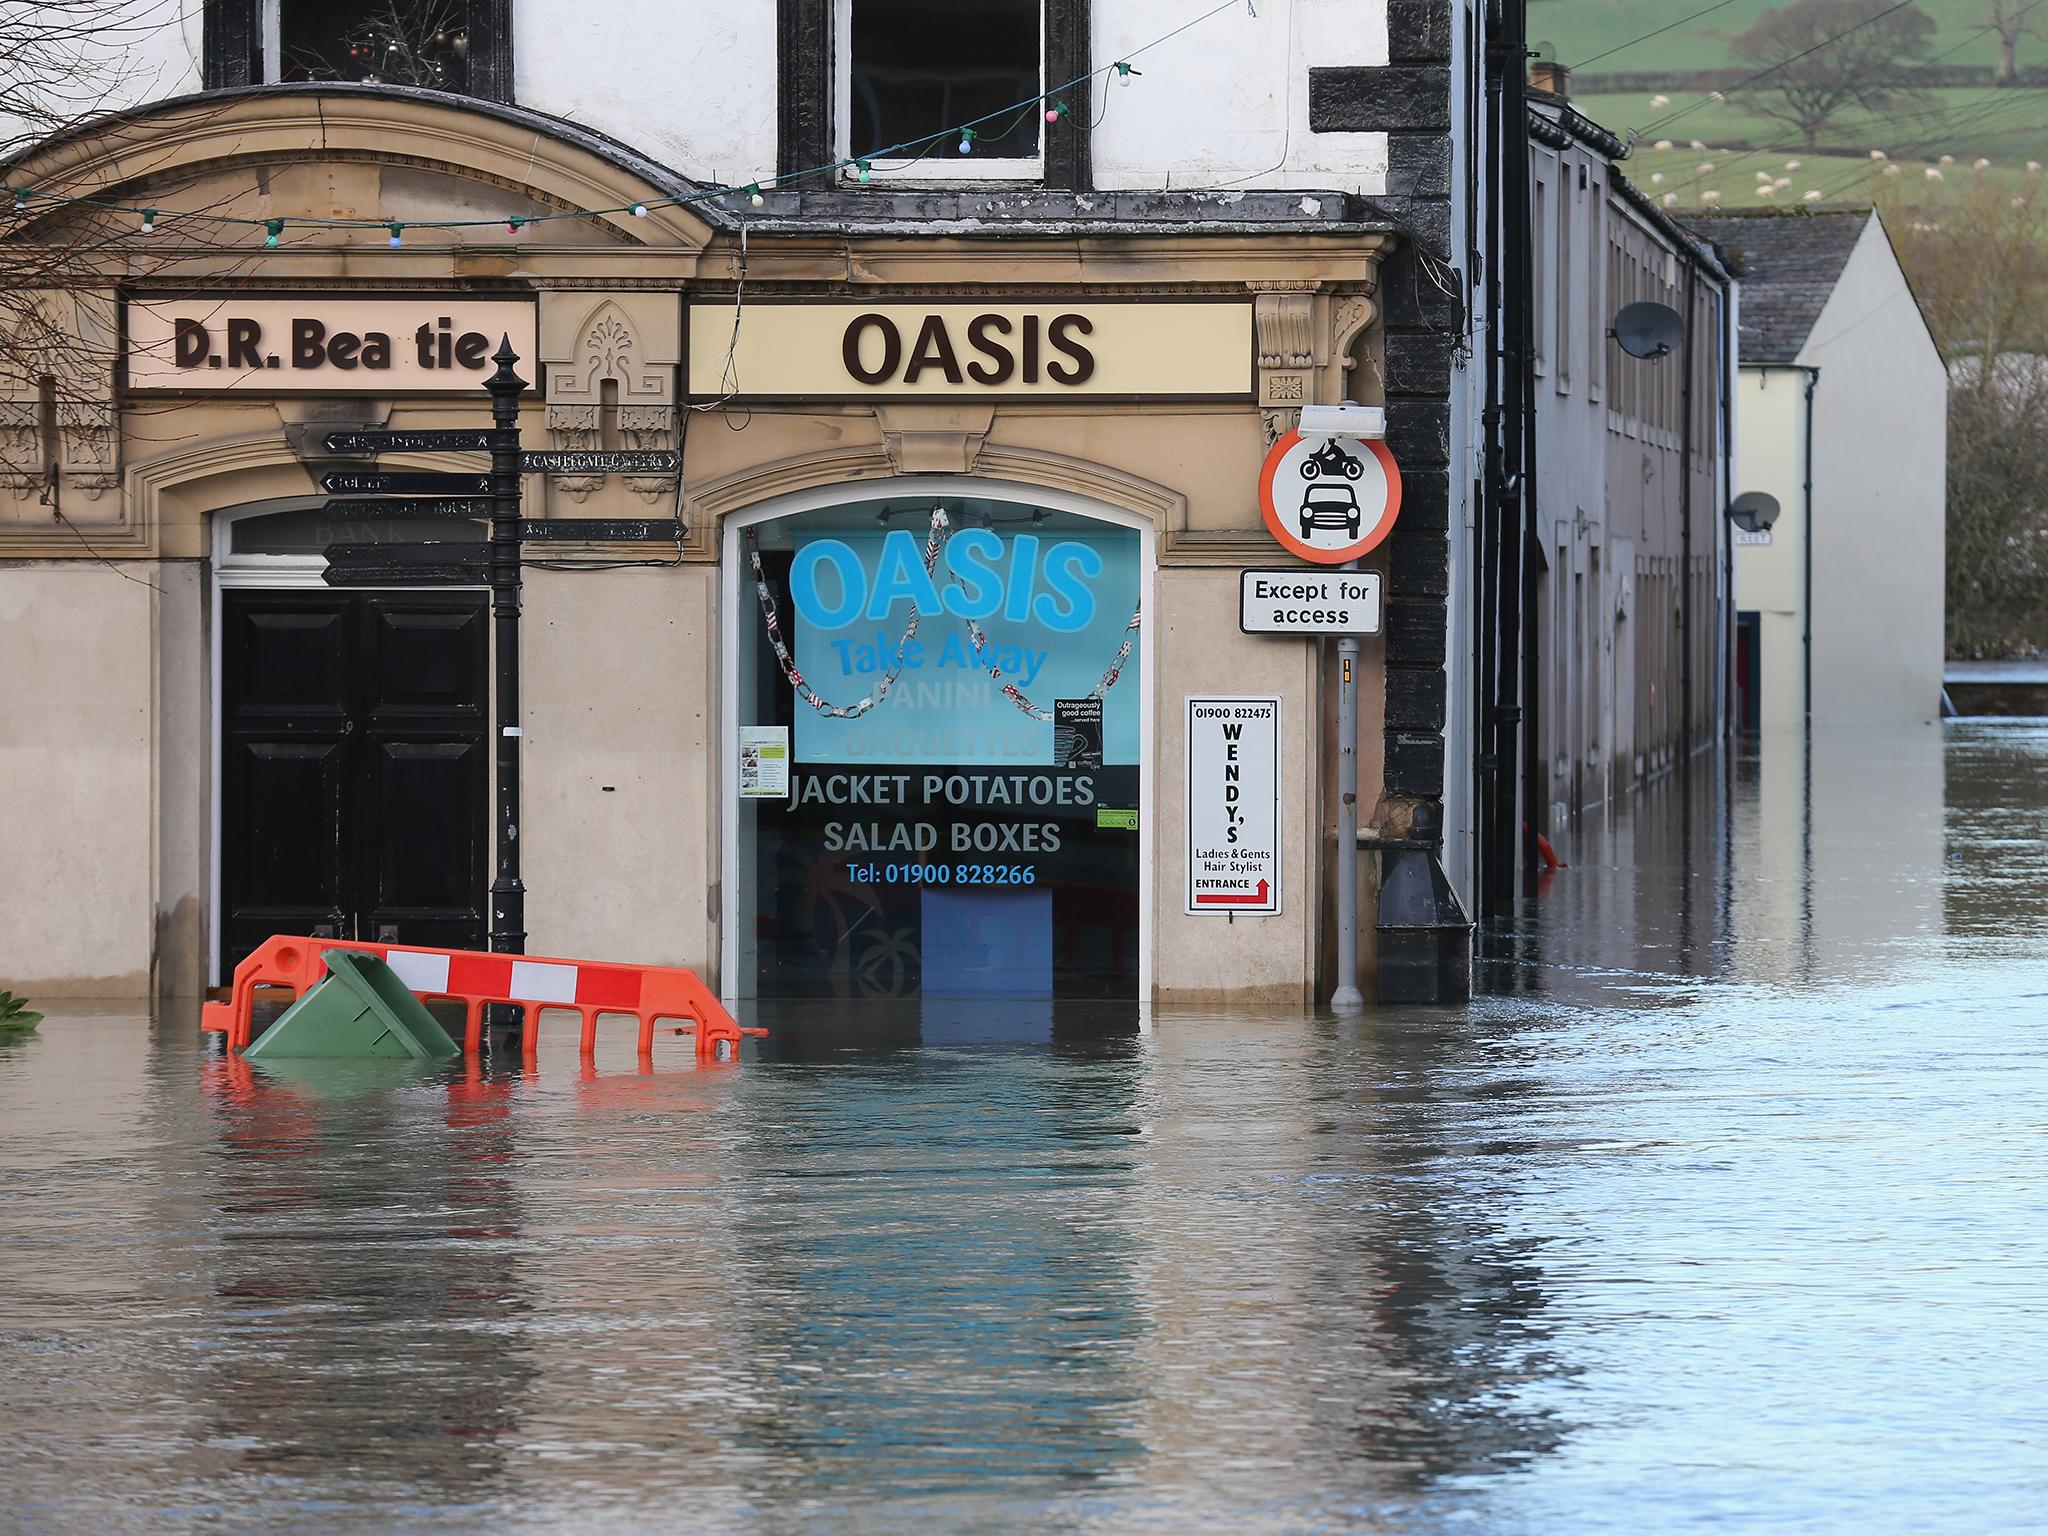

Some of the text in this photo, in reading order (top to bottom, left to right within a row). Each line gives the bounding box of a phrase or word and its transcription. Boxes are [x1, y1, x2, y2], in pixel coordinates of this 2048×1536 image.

[843, 313, 1094, 387] OASIS
[315, 518, 406, 543] BANK
[789, 529, 1103, 633] OASIS
[1255, 580, 1370, 603] Except for
[1273, 609, 1349, 624] access
[831, 630, 1048, 688] Take Away
[873, 680, 991, 709] PANINI
[1056, 701, 1101, 710] Outrageously
[1061, 709, 1101, 717] good coffee
[1195, 707, 1271, 719] 01900 822475
[845, 727, 1041, 758] BAGUETTES
[786, 775, 911, 812] JACKET
[923, 775, 1094, 805] POTATOES
[824, 822, 1061, 852] SALAD BOXES
[1195, 848, 1271, 859] Ladies & Gents
[846, 862, 1035, 884] Tel: 01900 828266
[1203, 860, 1263, 875] Hair Stylist
[1195, 878, 1250, 889] ENTRANCE
